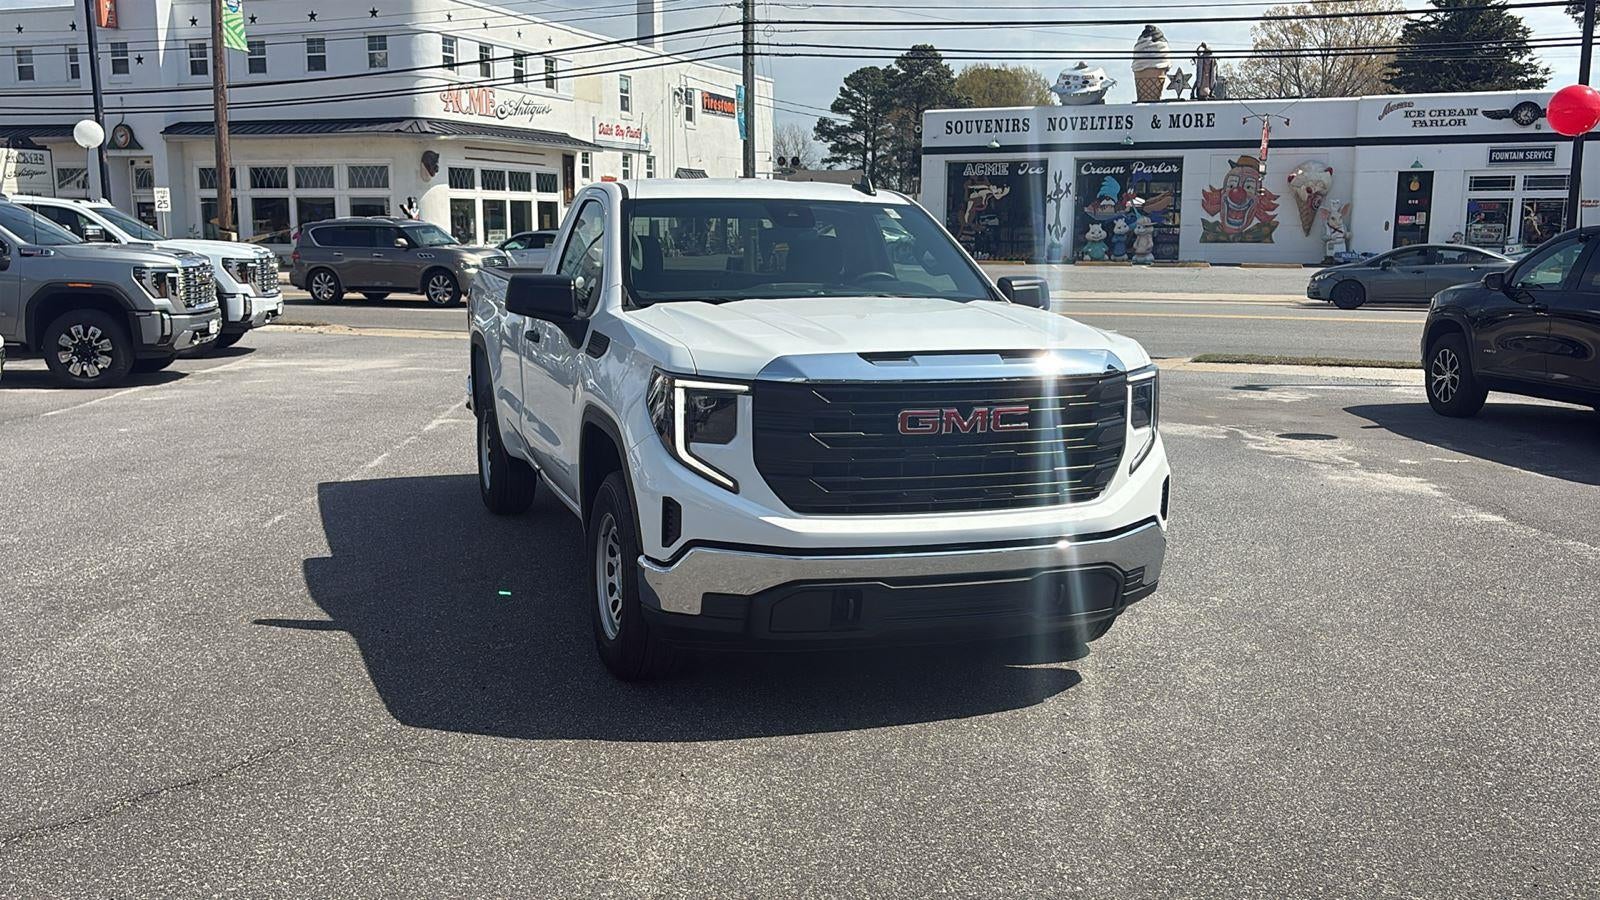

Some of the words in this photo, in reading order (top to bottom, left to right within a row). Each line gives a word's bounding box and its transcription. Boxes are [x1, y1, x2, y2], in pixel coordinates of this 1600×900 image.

[440, 84, 496, 118] ACME
[496, 95, 552, 122] Antiques
[703, 91, 735, 114] Firestone
[1404, 110, 1425, 119] ICE
[1429, 108, 1478, 118] CREAM
[945, 117, 1030, 135] SOUVENIRS
[1047, 115, 1134, 132] NOVELTIES
[1150, 115, 1162, 130] &
[1168, 113, 1216, 129] MORE
[1411, 118, 1467, 128] PARLOR
[1491, 151, 1524, 161] FOUNTAIN
[1525, 150, 1553, 160] SERVICE
[963, 162, 1009, 176] ACME
[1017, 163, 1046, 175] Ice
[1081, 162, 1125, 175] Cream
[1131, 161, 1180, 174] Parlor
[157, 200, 169, 209] 25
[898, 405, 1030, 435] GMC
